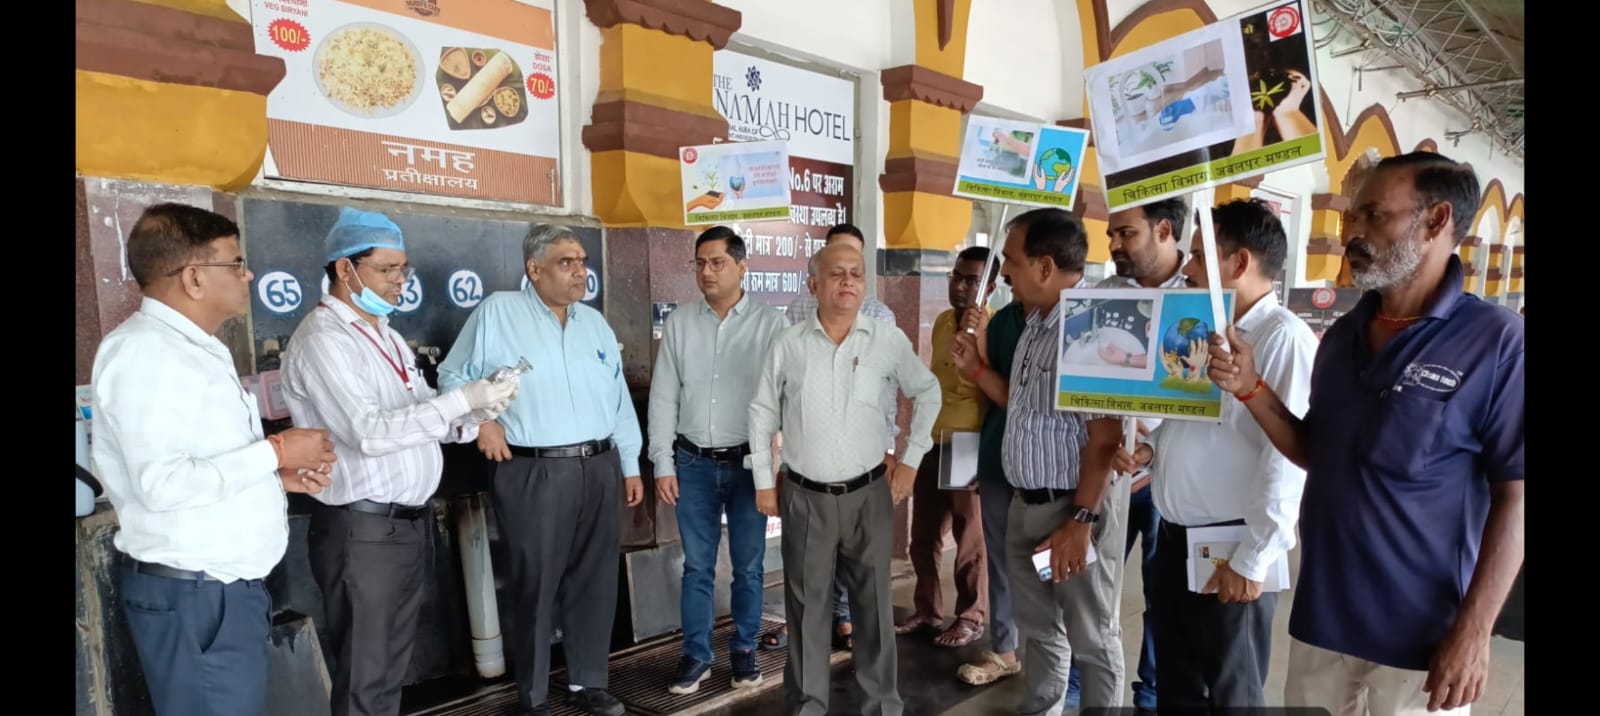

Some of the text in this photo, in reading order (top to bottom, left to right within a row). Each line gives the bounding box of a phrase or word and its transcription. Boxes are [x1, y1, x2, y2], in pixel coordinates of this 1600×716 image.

[264, 1, 280, 11] VEG
[280, 5, 308, 17] BIRYANI
[272, 25, 307, 45] 100/-
[532, 62, 552, 73] DOSA
[530, 77, 554, 95] 70/-
[713, 74, 733, 90] THE
[715, 88, 851, 141] NAMAH HOTEL
[381, 141, 476, 174] नमह
[1215, 157, 1261, 177] जबलपुर
[1264, 145, 1303, 163] मण्डल
[382, 167, 479, 190] प्रतीक्षालय
[812, 173, 823, 194] पर
[810, 206, 836, 227] उपलब्ध
[755, 234, 774, 256] मात्र
[775, 234, 803, 259] 200/-
[265, 280, 301, 306] 65
[451, 280, 482, 302] 62
